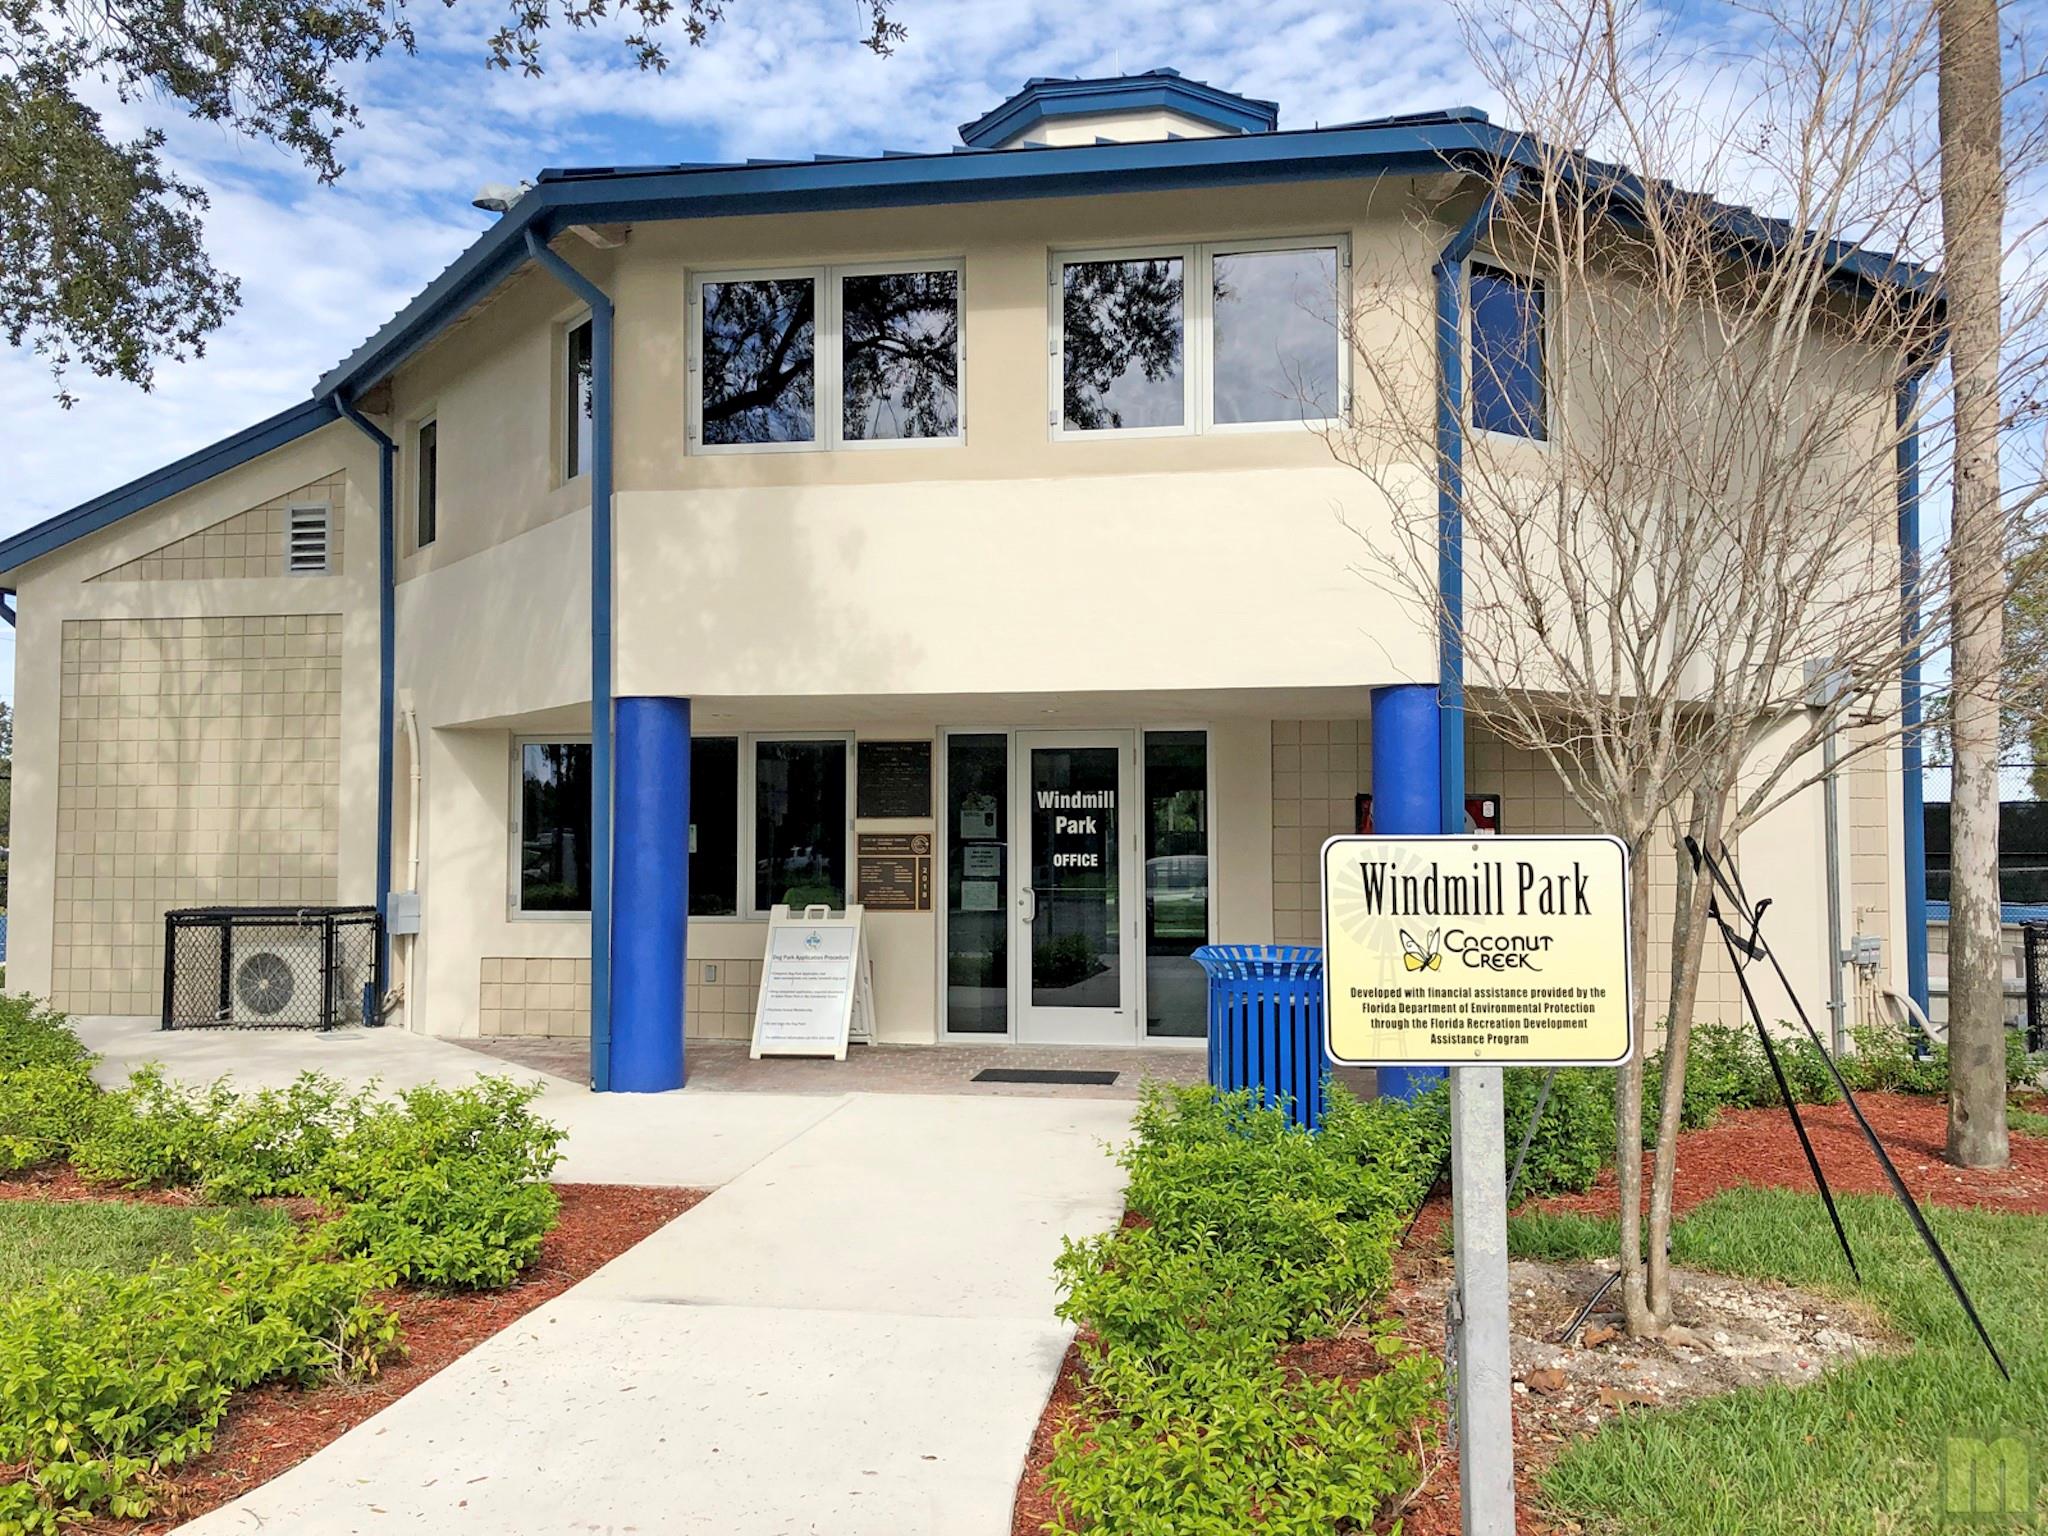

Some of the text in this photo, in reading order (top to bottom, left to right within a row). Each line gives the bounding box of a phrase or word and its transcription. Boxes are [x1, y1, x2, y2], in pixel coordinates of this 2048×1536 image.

[1036, 790, 1115, 809] Windmill
[1055, 815, 1097, 835] Park
[1053, 853, 1099, 868] OFFICE
[1359, 861, 1593, 916] Windmill Park
[1350, 987, 1607, 999] Developed with financial assistance provided by the
[1362, 1003, 1596, 1015] Florida Department of Environmental Protection
[1370, 1018, 1588, 1030] through the Florida Recreation Development
[1430, 1033, 1530, 1046] Assistance Program
